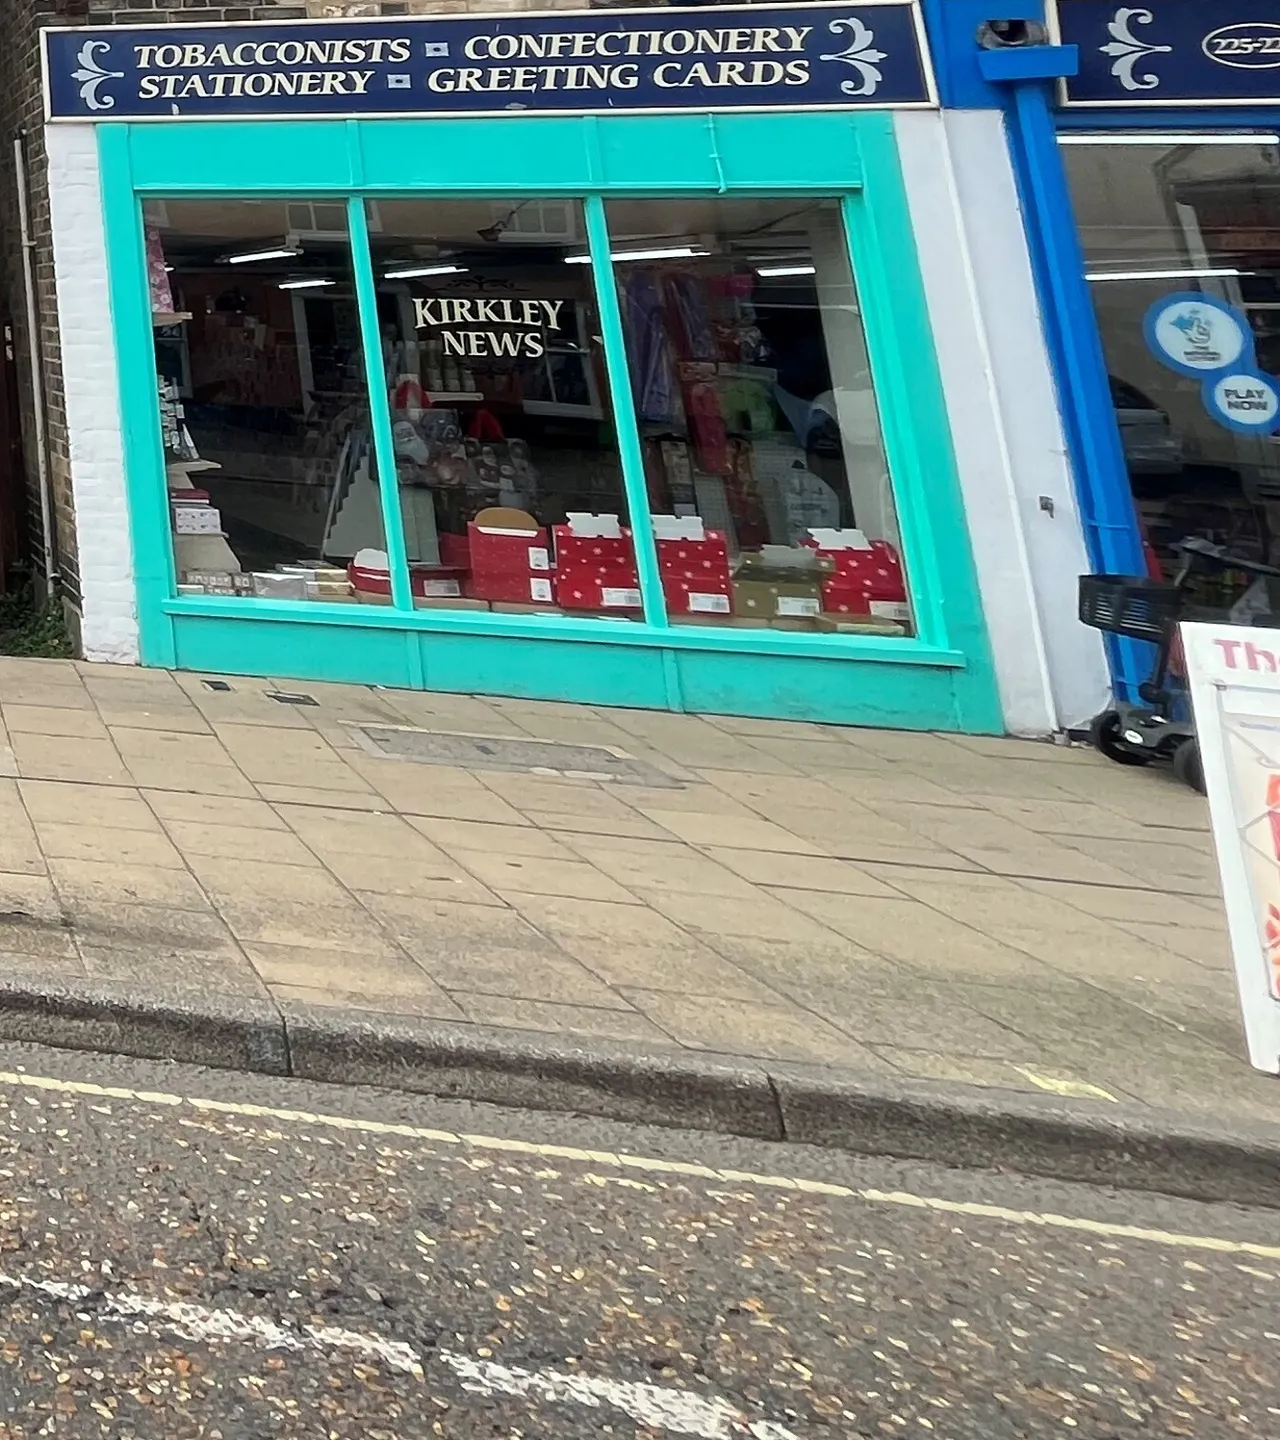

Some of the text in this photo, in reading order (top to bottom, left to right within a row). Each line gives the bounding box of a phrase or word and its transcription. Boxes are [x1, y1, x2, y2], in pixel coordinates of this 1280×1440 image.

[134, 26, 813, 68] TOBACCONISTS CONFECTIONERY
[139, 60, 810, 98] STATIONERY GREETING CARDS
[412, 298, 564, 330] KIRKLEY
[441, 331, 544, 357] NEWS
[1224, 389, 1265, 399] PLAY
[1227, 401, 1268, 410] NOW
[1212, 639, 1280, 672] Th
